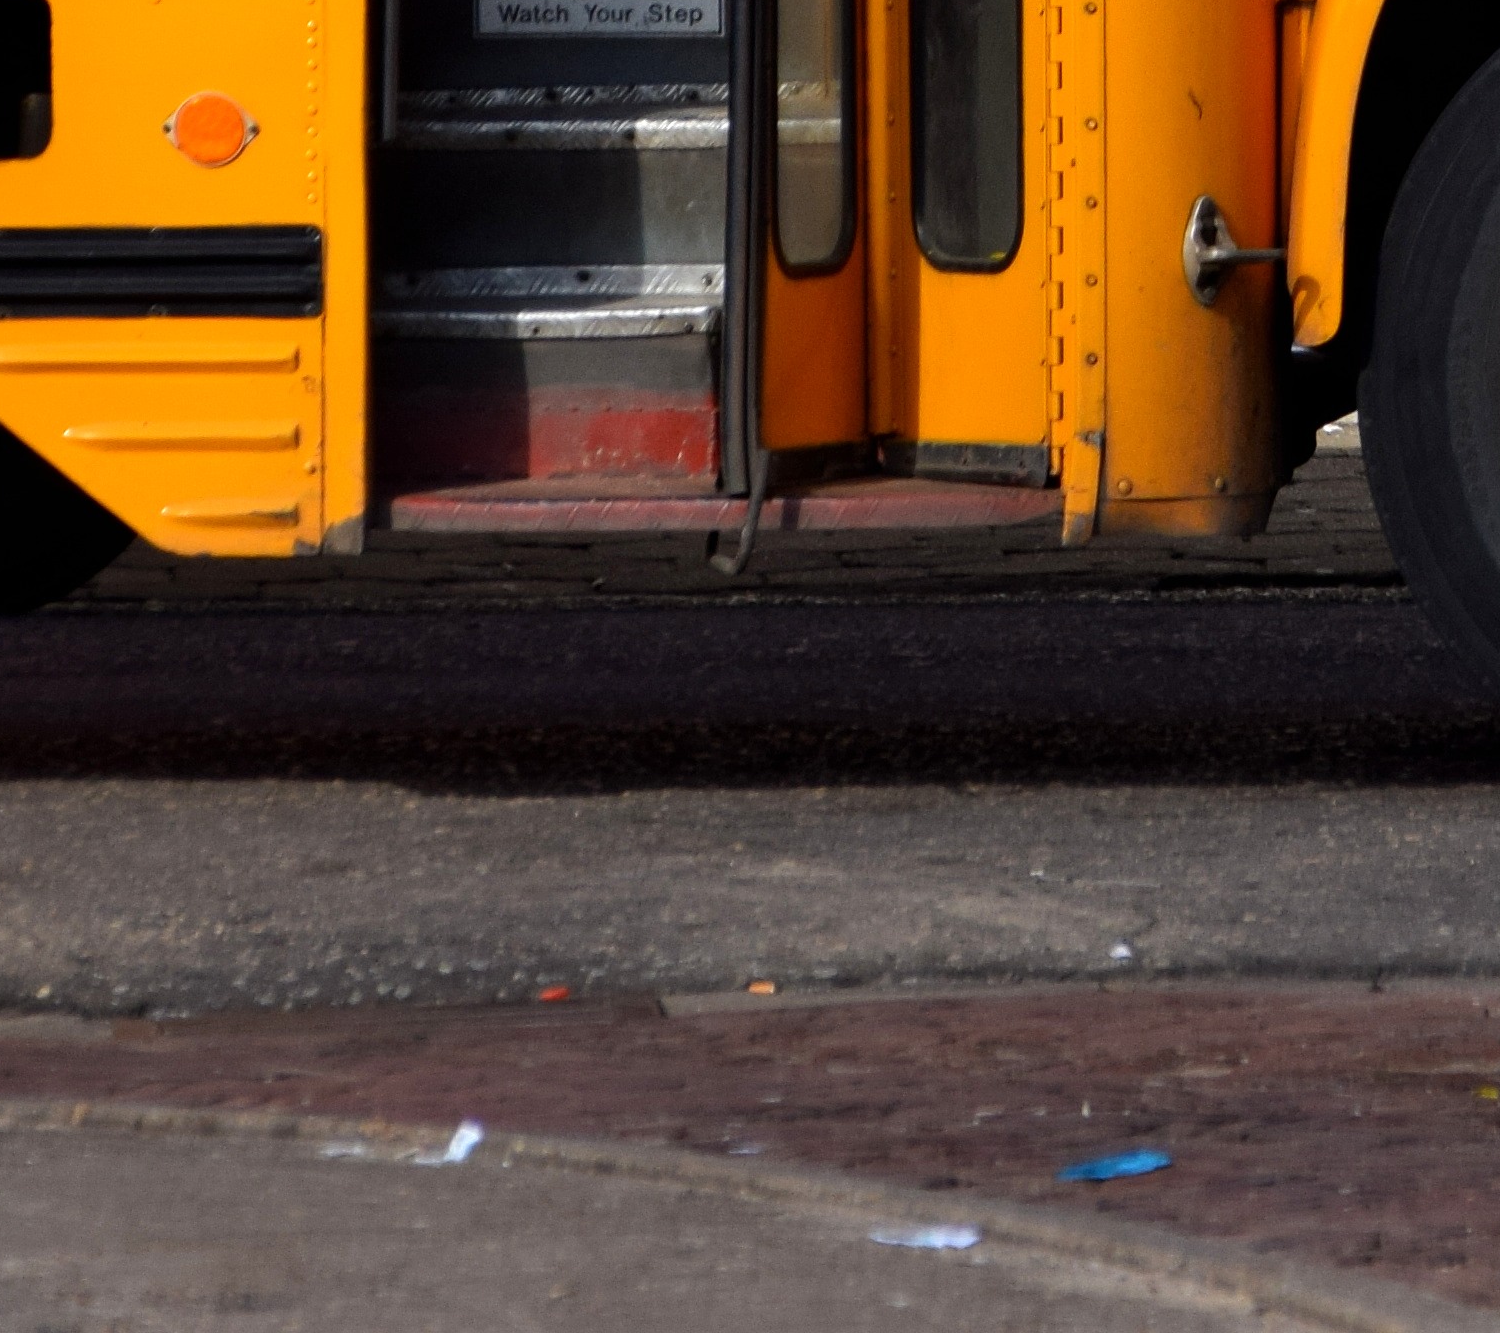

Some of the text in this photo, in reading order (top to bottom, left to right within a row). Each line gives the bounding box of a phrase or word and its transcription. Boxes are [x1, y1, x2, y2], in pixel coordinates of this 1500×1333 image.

[498, 2, 704, 27] Watch Your Step
